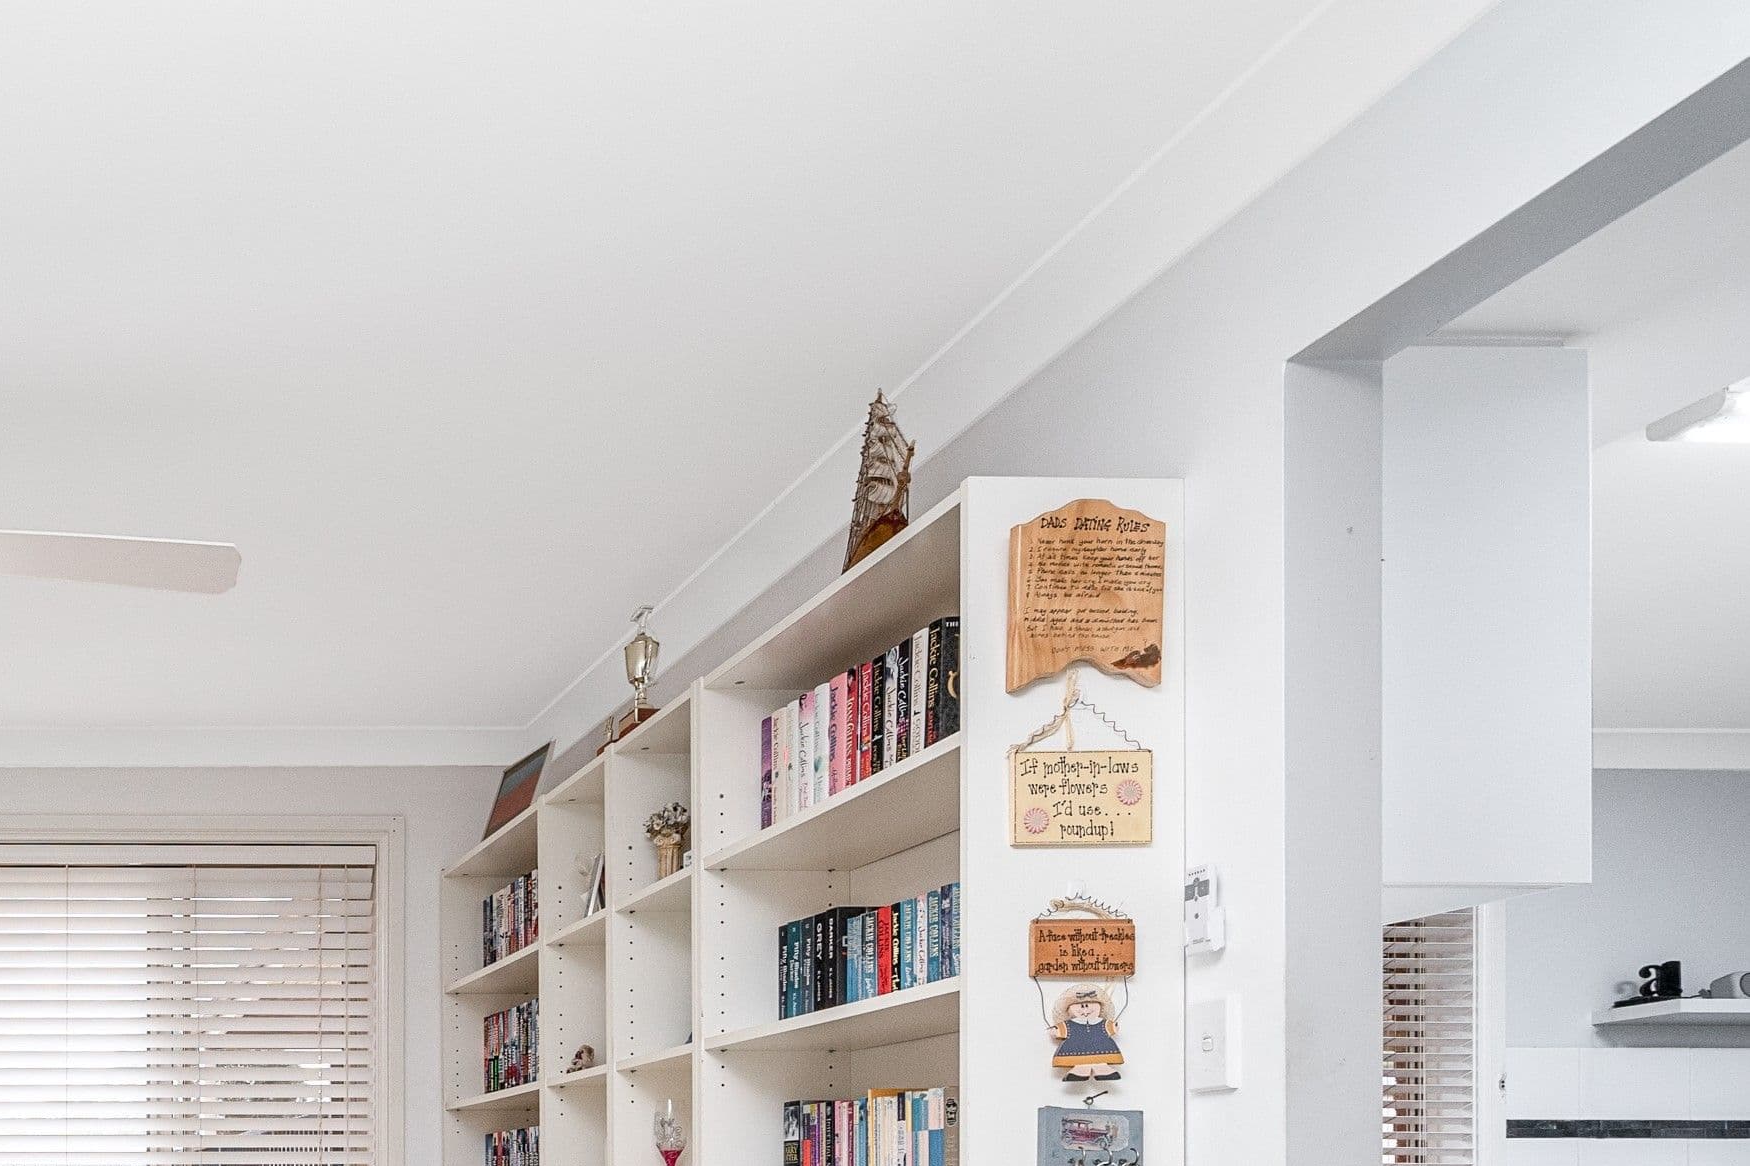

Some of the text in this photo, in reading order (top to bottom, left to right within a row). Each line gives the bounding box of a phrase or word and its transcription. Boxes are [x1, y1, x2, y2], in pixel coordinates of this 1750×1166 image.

[1041, 516, 1150, 533] DADS DATING RULES
[898, 657, 908, 689] Jackie
[927, 626, 940, 708] Jackie Collins
[862, 669, 871, 700] Jackie
[798, 722, 809, 778] Jackie Collins
[1020, 756, 1139, 778] If mother-in-laws
[1028, 778, 1108, 798] were flowers
[1053, 800, 1073, 817] I'd
[1060, 820, 1114, 840] roundup!
[929, 896, 938, 923] JACKIE
[865, 916, 874, 973] JACKIE COLLINS
[1046, 930, 1066, 941] face
[1068, 928, 1098, 943] without
[1059, 945, 1068, 956] is
[1038, 959, 1068, 973] garden
[1071, 957, 1100, 972] without
